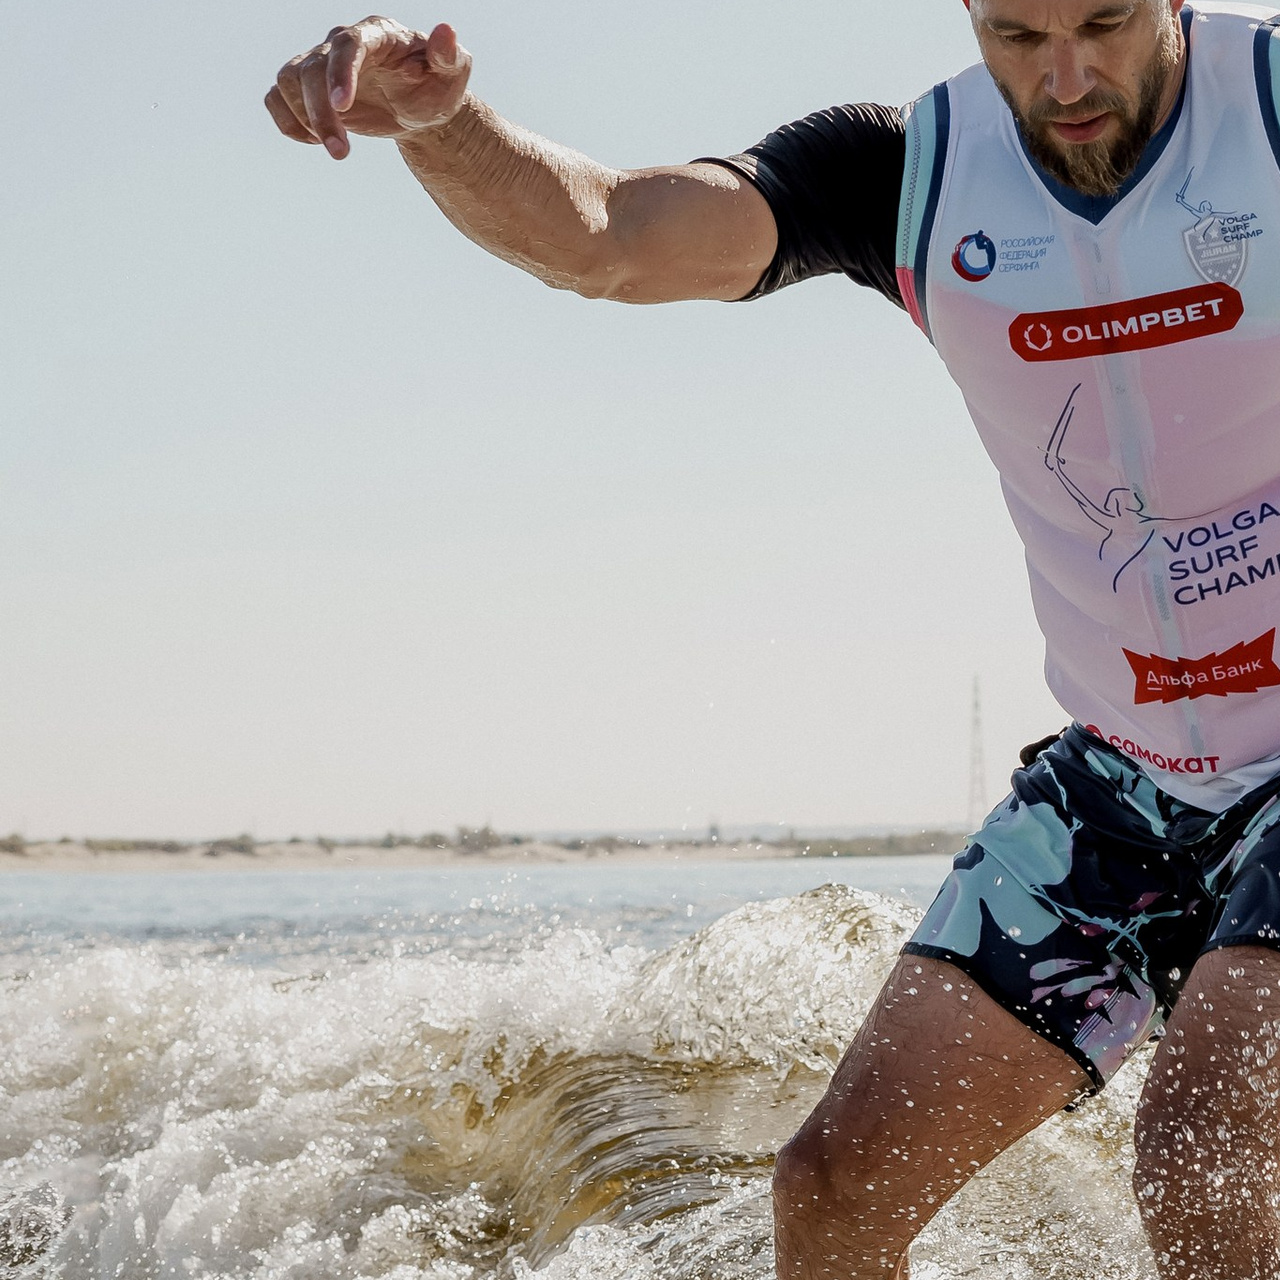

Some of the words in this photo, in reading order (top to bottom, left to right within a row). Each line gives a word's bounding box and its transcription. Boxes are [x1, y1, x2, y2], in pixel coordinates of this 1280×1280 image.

[1218, 213, 1258, 226] VOLGA
[1220, 223, 1250, 235] SURF
[1000, 235, 1055, 248] РОССИЙСКАЯ
[1223, 229, 1263, 243] CHAMP
[999, 248, 1047, 261] ФЕДЕРАЦИЯ
[998, 262, 1040, 273] СЕРФИНГА
[1061, 298, 1224, 343] OLIMPBET
[1162, 502, 1280, 553] VOLGA
[1168, 534, 1259, 580] SURF
[1146, 670, 1209, 689] Альфа
[1212, 658, 1264, 681] Банк
